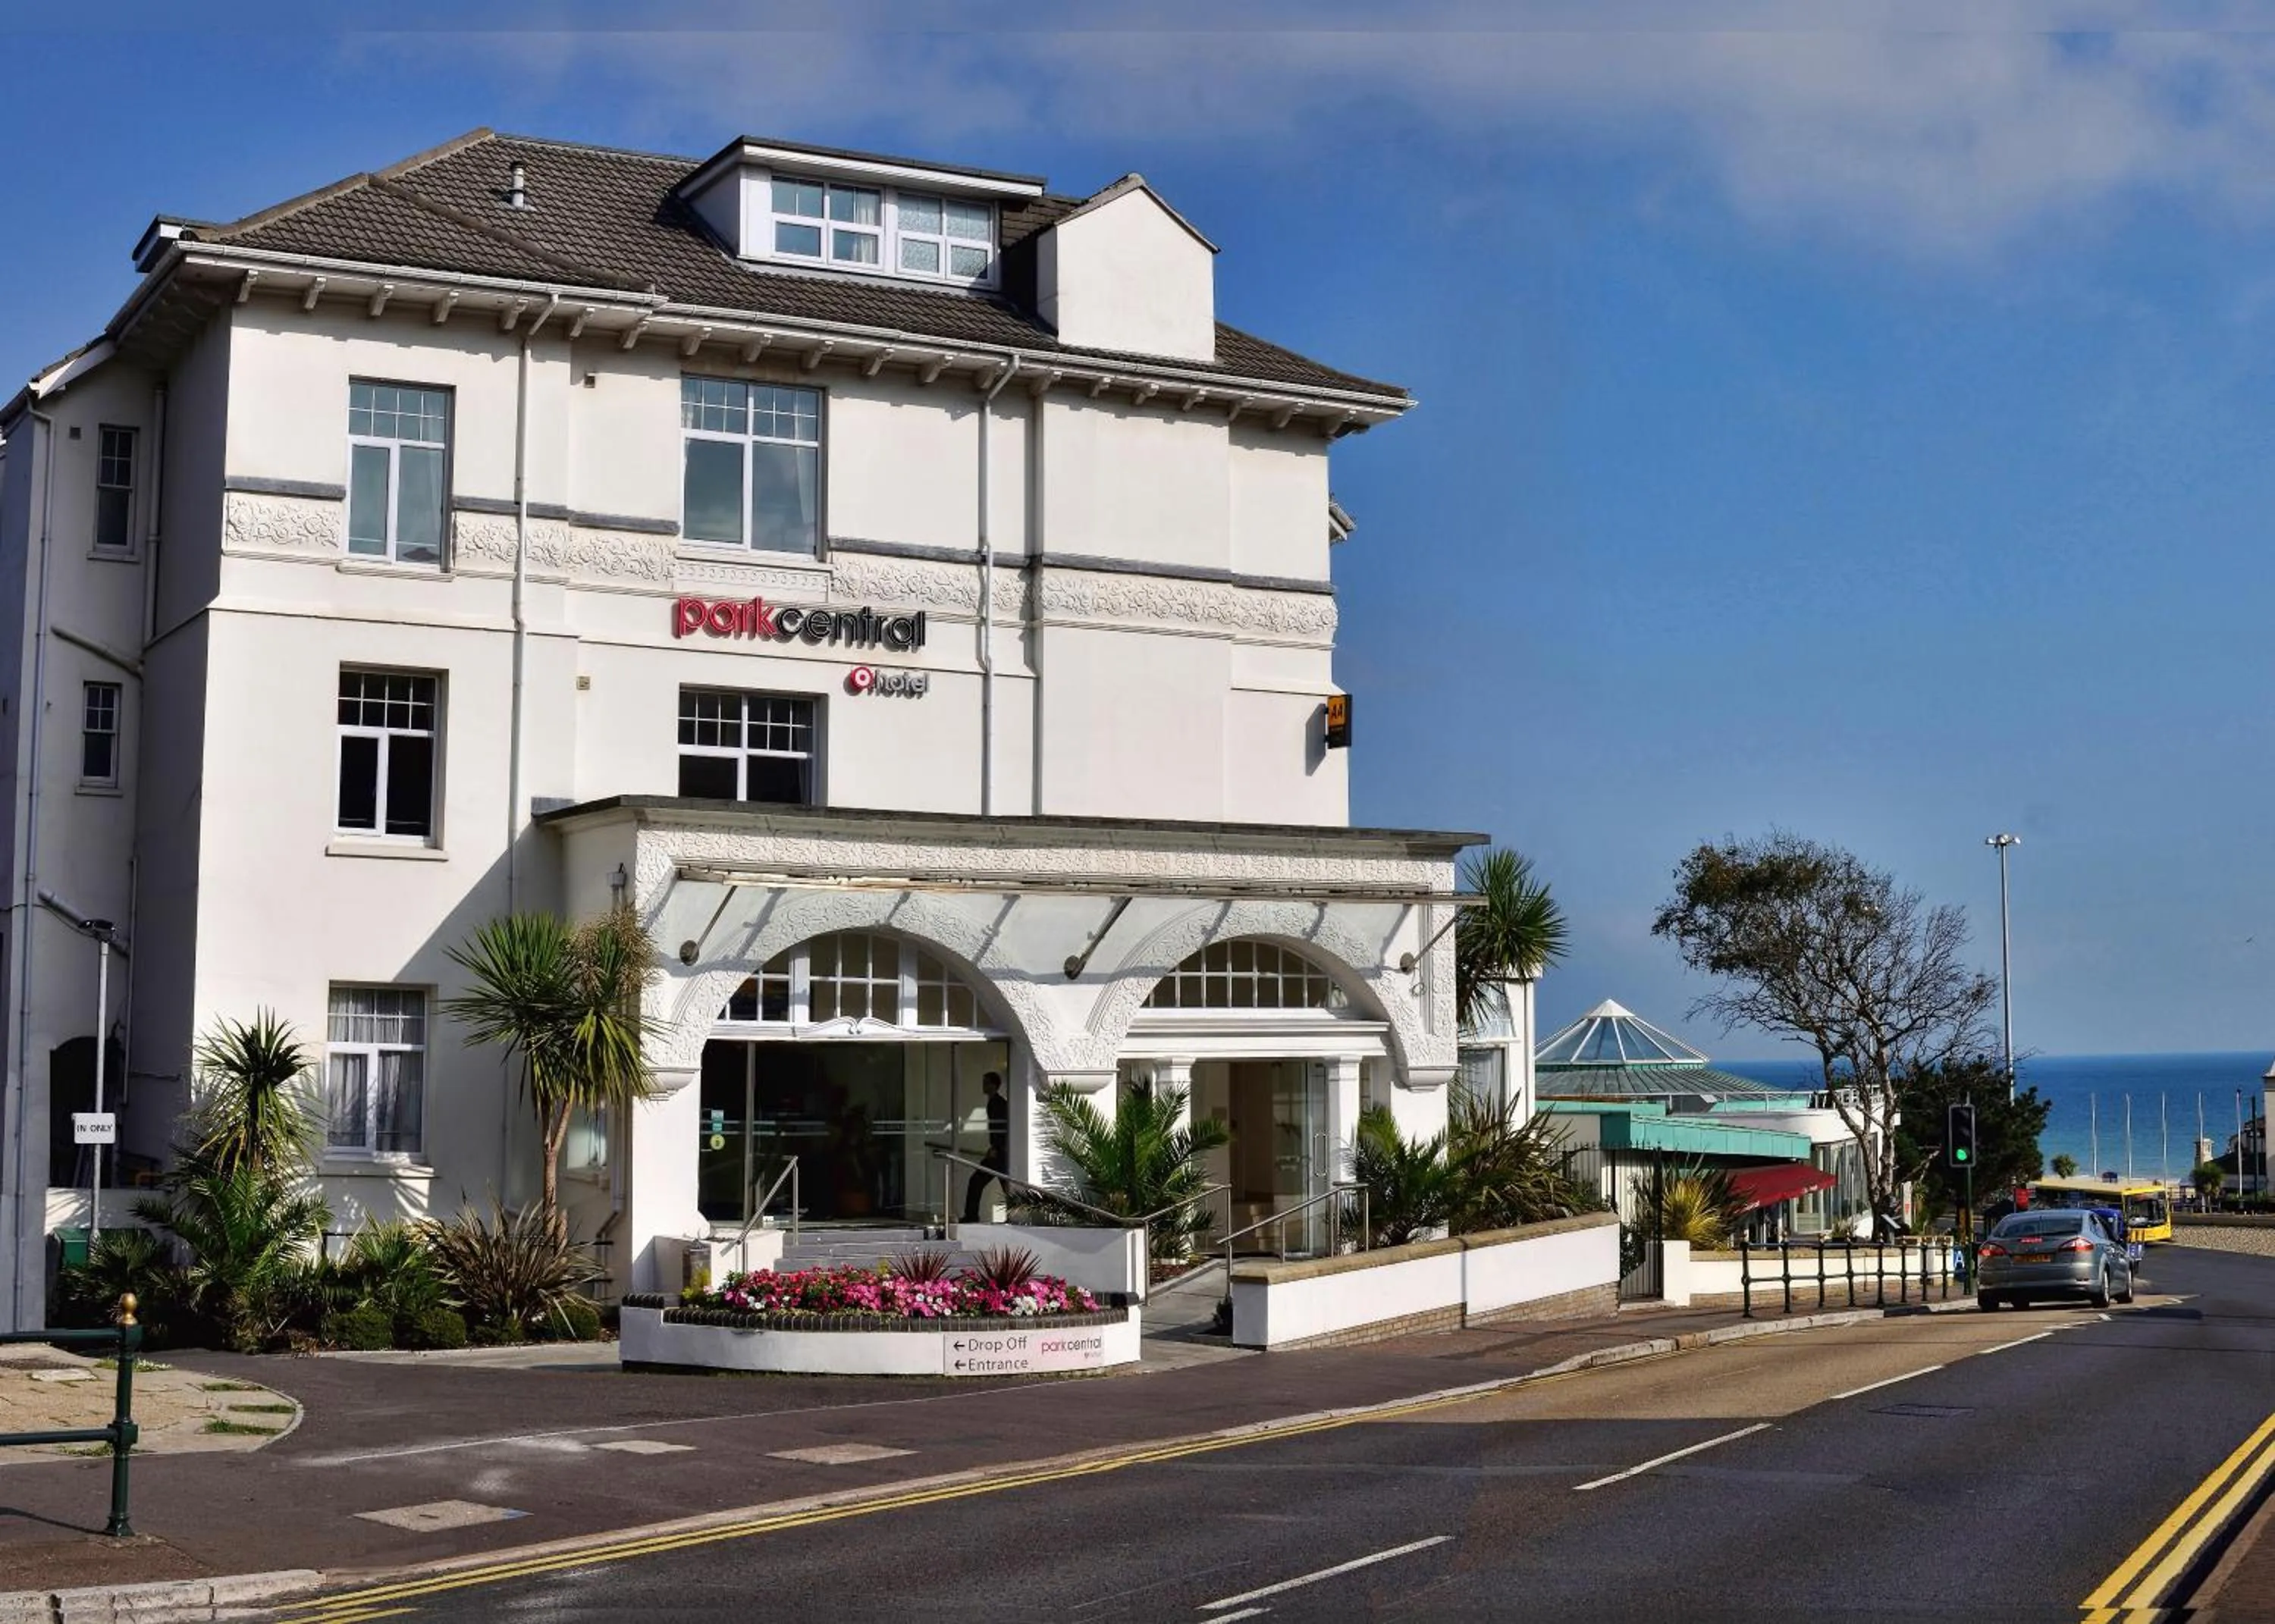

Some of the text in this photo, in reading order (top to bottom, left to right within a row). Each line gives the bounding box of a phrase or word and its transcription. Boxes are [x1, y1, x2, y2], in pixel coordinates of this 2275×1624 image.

[677, 597, 926, 647] parkcentral
[875, 669, 929, 694] hotel
[77, 1124, 113, 1133] IN ONLY
[968, 1336, 1028, 1353] Drop Off
[1041, 1336, 1102, 1356] parkcentral
[968, 1358, 1028, 1372] Entrance
